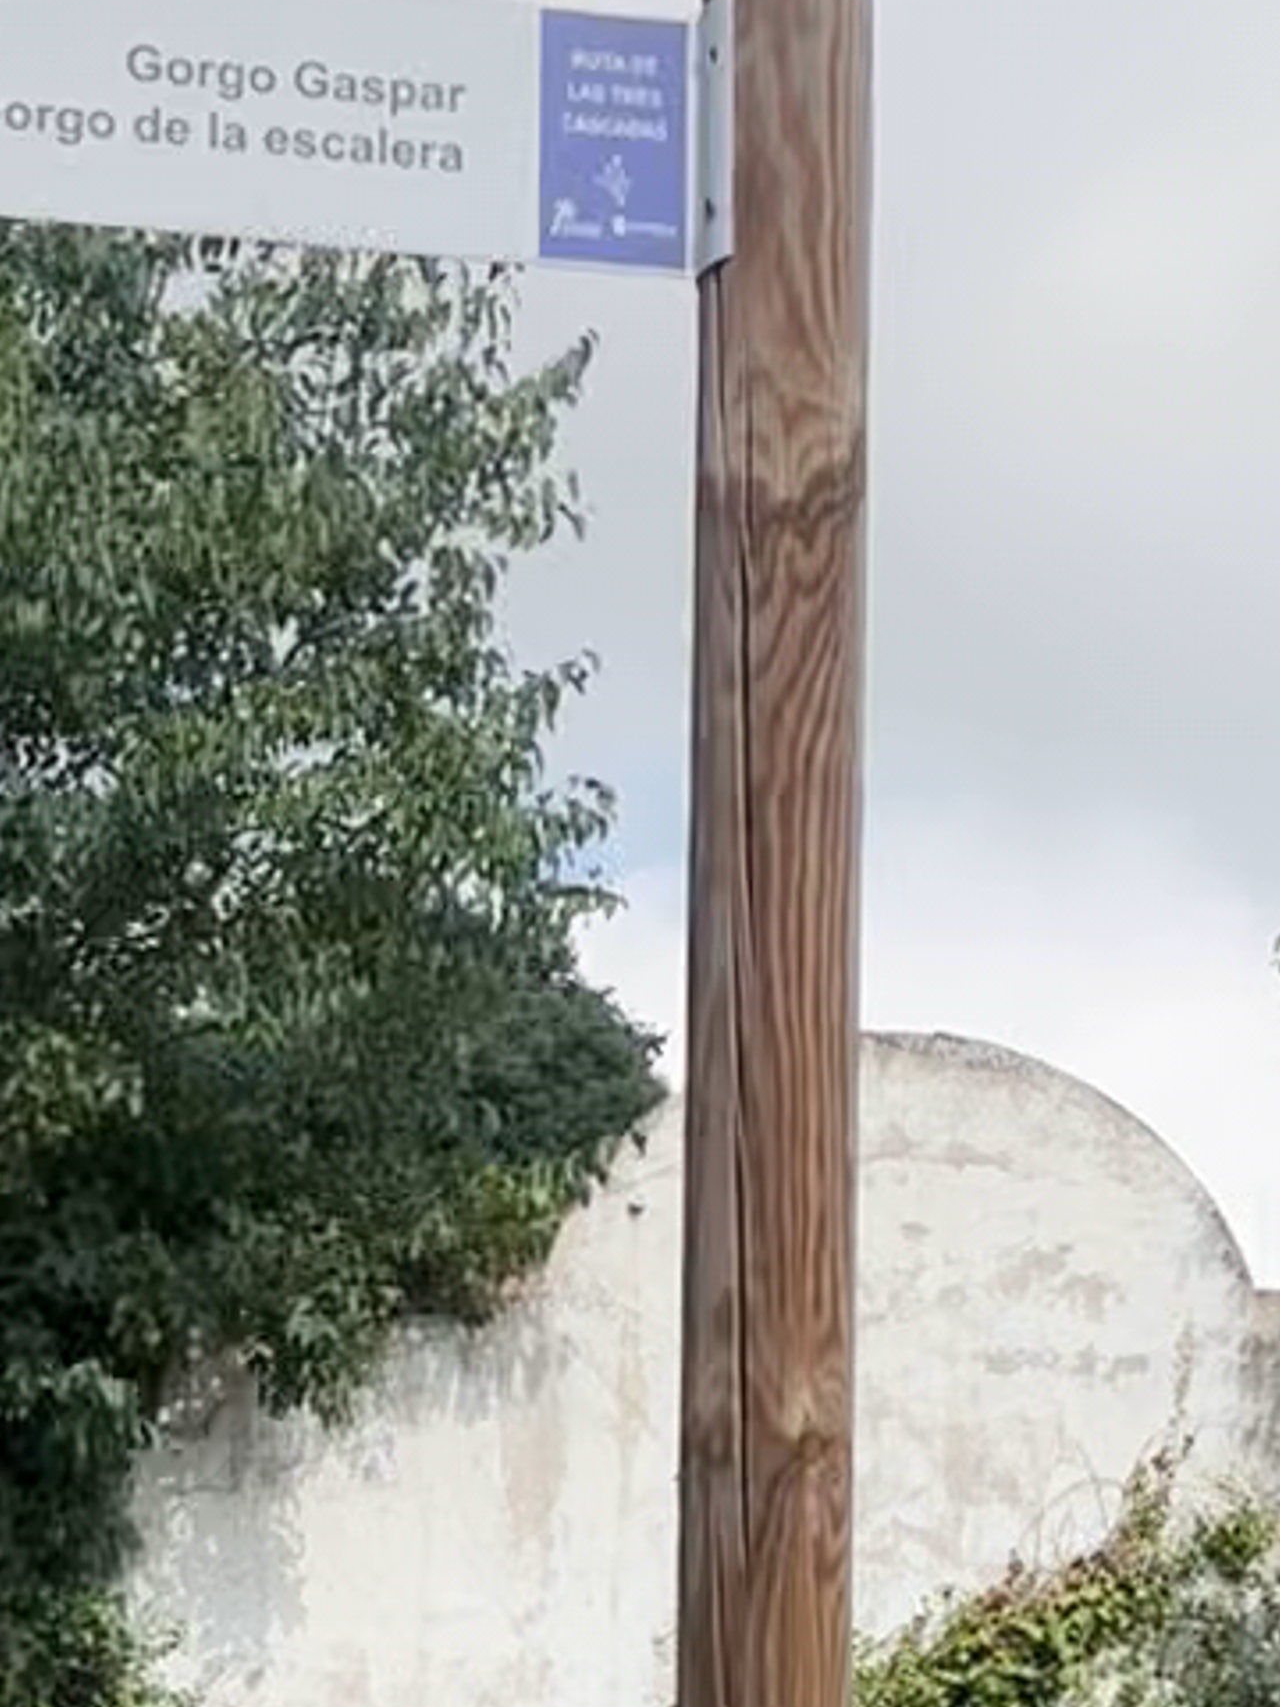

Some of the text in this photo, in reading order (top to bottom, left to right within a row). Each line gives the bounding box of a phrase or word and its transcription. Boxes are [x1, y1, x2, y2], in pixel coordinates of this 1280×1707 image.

[124, 42, 278, 103] Gorgo
[292, 59, 468, 118] Gaspar
[131, 104, 193, 148] de
[207, 110, 249, 154] la
[260, 125, 464, 174] escalera
